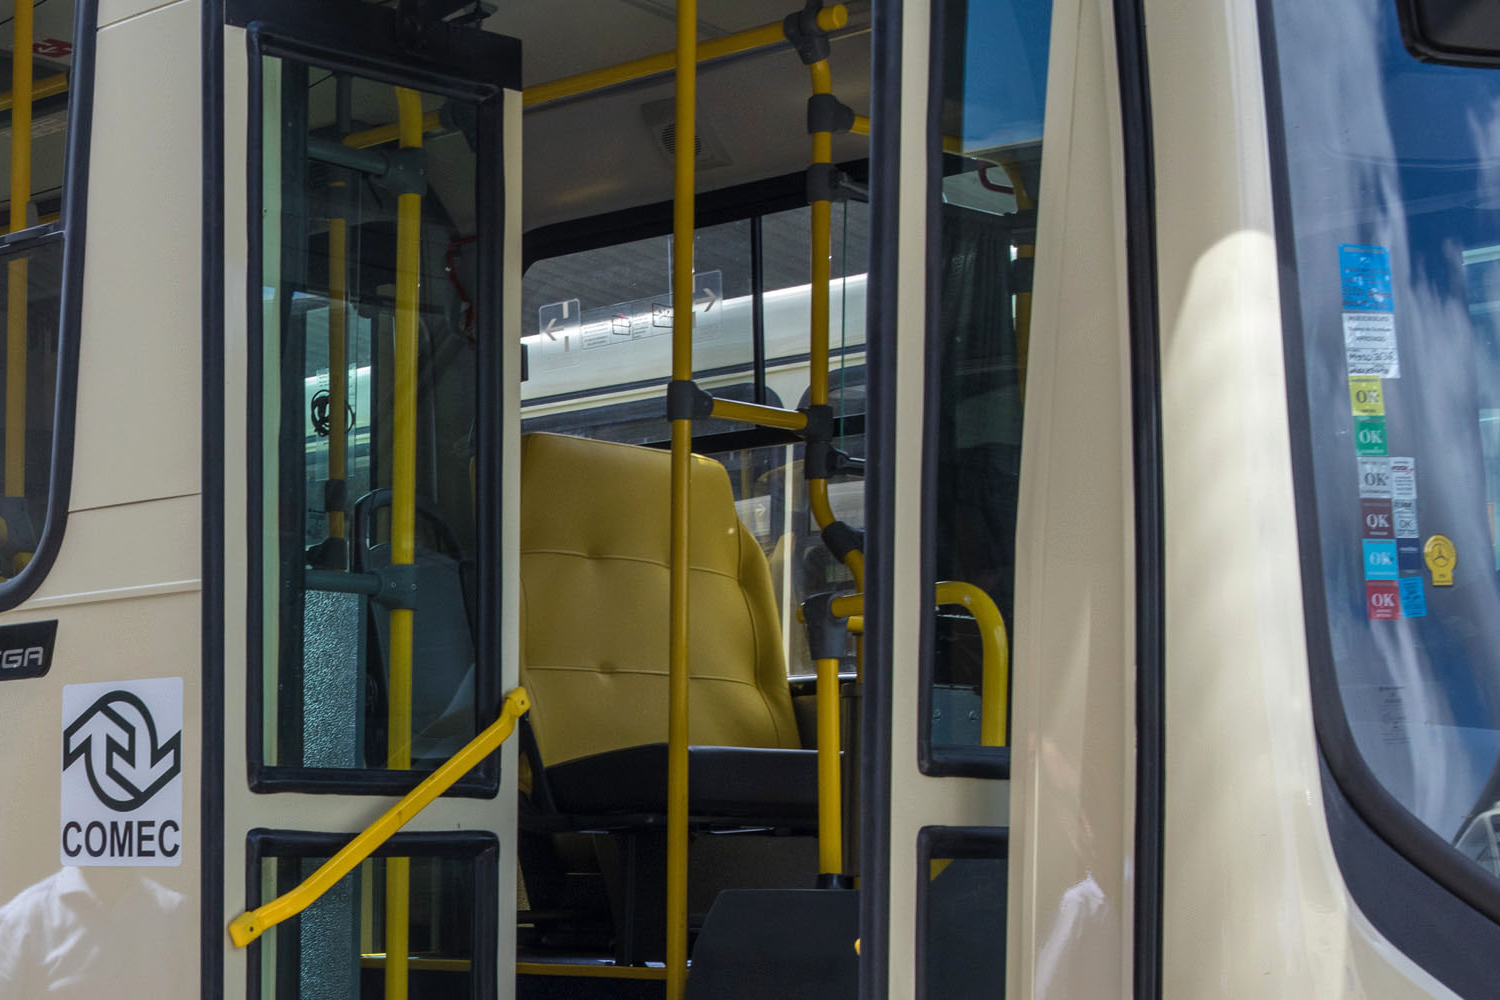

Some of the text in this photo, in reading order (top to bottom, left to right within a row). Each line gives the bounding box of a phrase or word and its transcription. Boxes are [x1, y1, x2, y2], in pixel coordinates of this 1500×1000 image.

[1359, 429, 1383, 444] OK
[1364, 472, 1388, 487] OK
[1366, 512, 1390, 529] OK
[1368, 551, 1393, 566] OK
[1371, 592, 1395, 608] OK
[62, 819, 180, 858] COMEC
